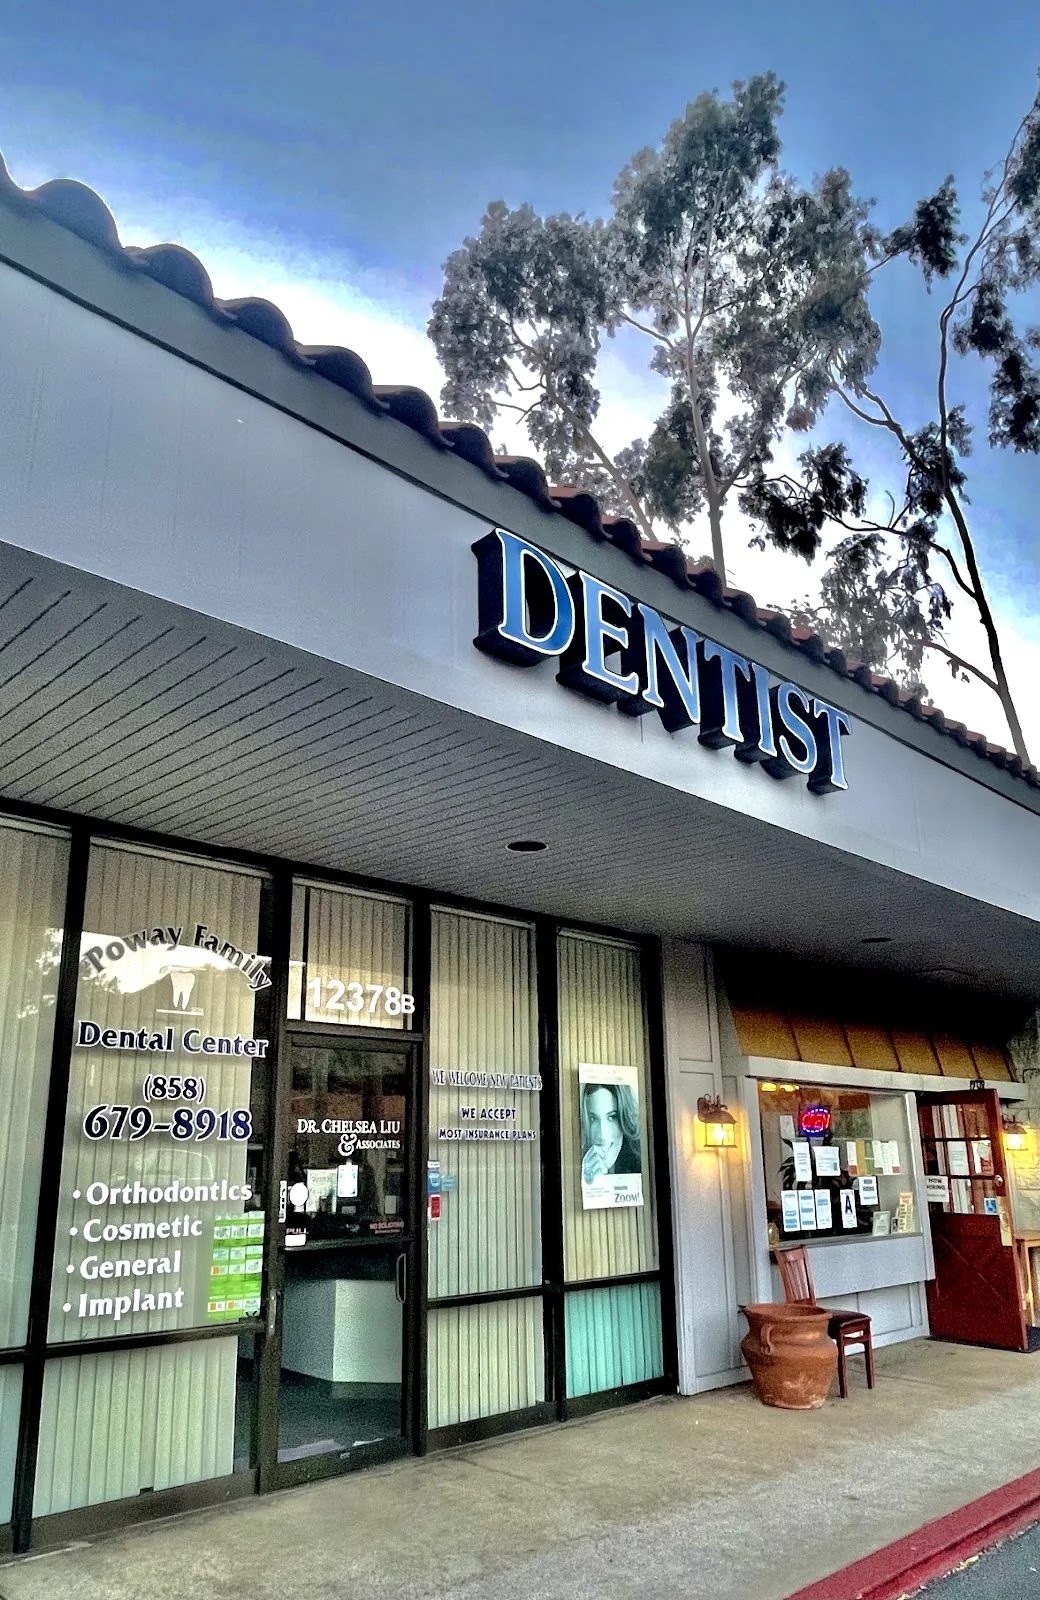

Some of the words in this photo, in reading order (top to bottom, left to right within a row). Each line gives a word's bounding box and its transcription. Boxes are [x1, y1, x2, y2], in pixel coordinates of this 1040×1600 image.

[488, 527, 851, 791] DENTIST
[80, 925, 183, 973] Poway
[194, 924, 272, 991] Family
[76, 1020, 174, 1052] Dental
[182, 1029, 269, 1058] Center
[143, 1074, 206, 1103] (858)
[432, 1069, 446, 1085] WE
[449, 1070, 488, 1087] WELCOME
[490, 1074, 508, 1088] NEW
[83, 1103, 252, 1141] 679-8918
[297, 1119, 320, 1134] DR.
[321, 1119, 377, 1135] CHELSEA
[380, 1120, 400, 1134] LIU
[461, 1108, 476, 1119] WE
[480, 1108, 516, 1120] ACCEPT
[338, 1133, 357, 1156] &
[356, 1139, 401, 1150] ASSOCIATES
[439, 1128, 462, 1140] MOST
[465, 1129, 509, 1140] INSURANCE
[512, 1130, 536, 1140] PLANS
[86, 1180, 253, 1205] Orthodontics
[845, 1195, 853, 1214] A
[83, 1214, 203, 1242] Cosmetic
[80, 1249, 181, 1280] General
[78, 1287, 185, 1320] Implant
